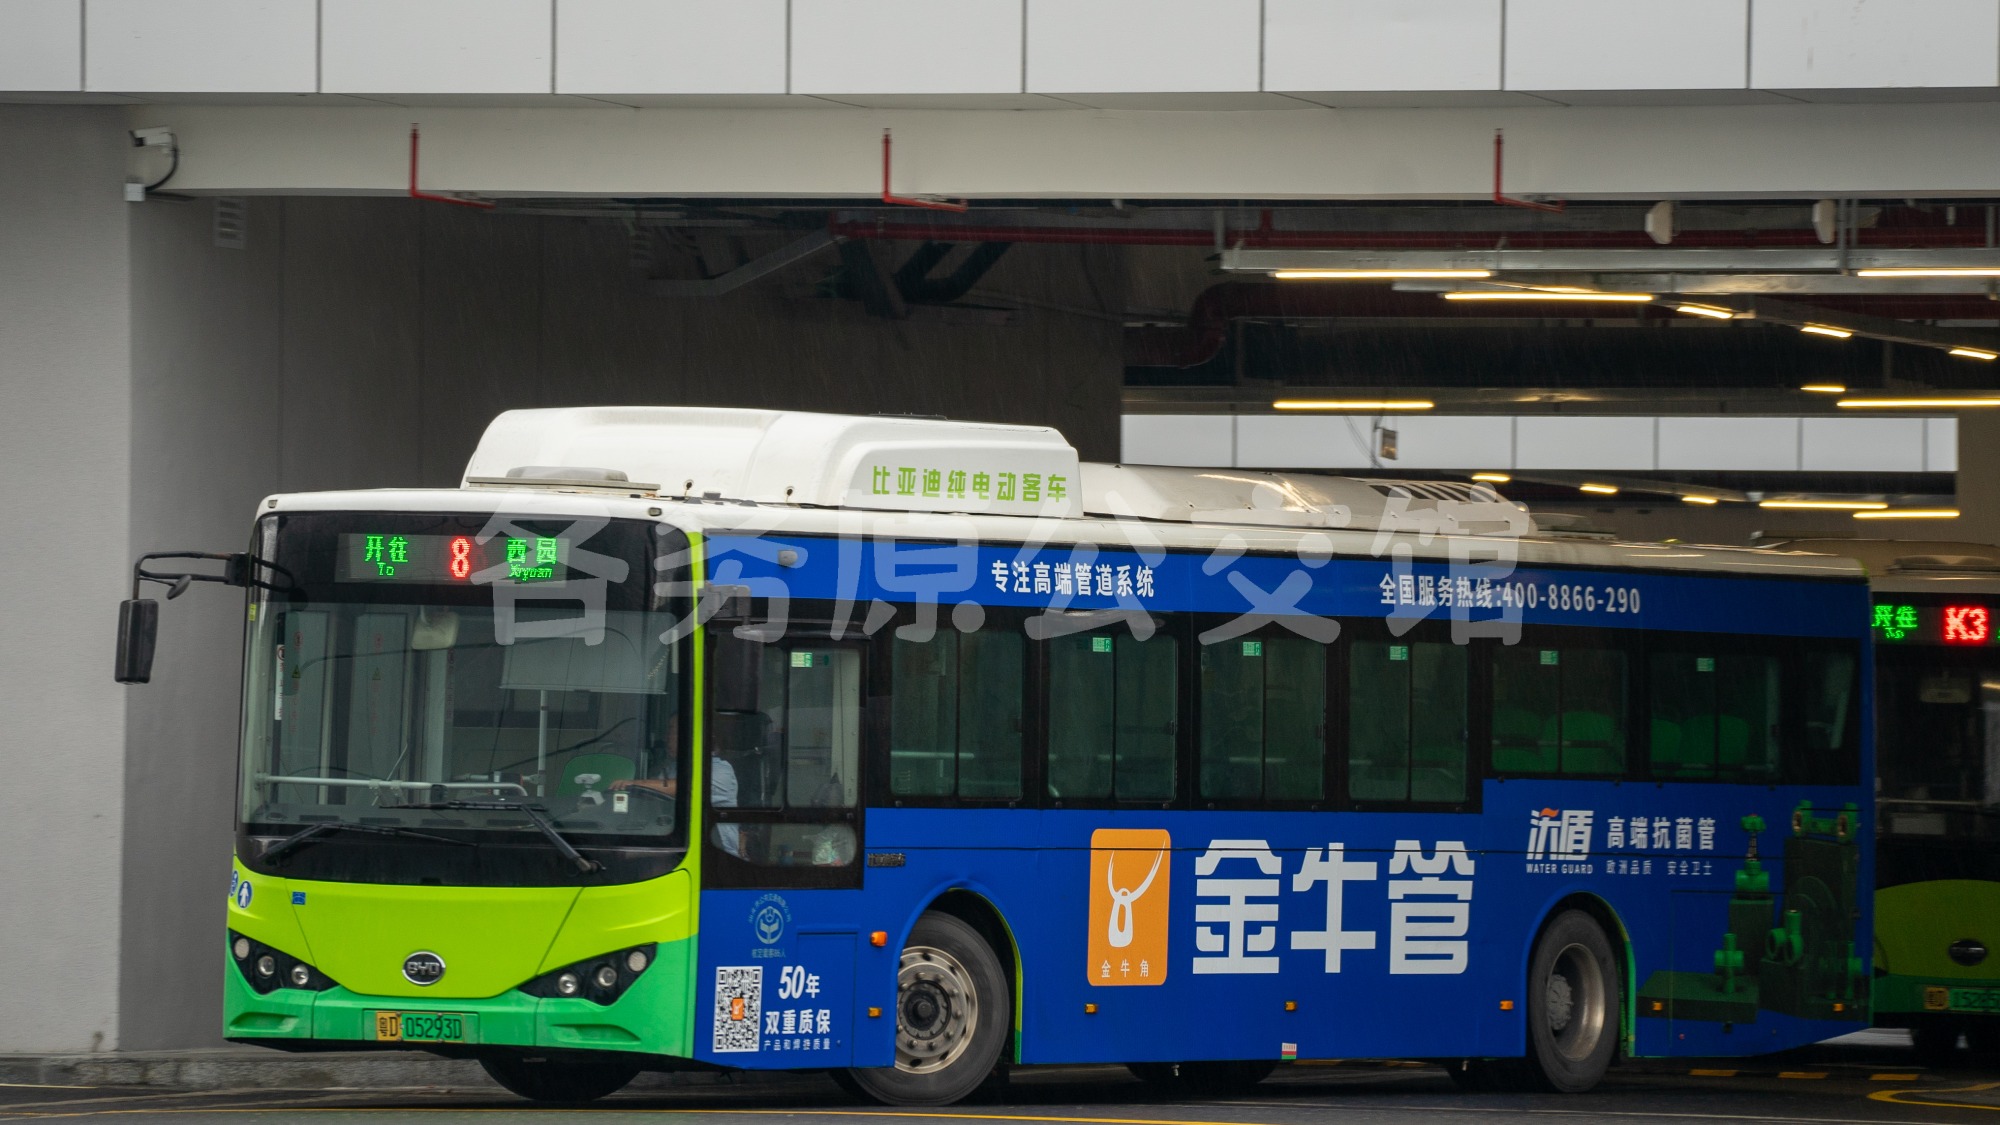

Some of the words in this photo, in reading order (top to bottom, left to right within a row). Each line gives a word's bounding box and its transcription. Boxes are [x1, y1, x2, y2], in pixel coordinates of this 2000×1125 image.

[872, 465, 1067, 503] 比亚迪纯电动客车
[364, 535, 409, 563] 开往
[450, 537, 471, 578] 8
[507, 537, 558, 564] 西园
[376, 562, 396, 576] To
[991, 560, 1154, 597] 专注高端管道系统
[1944, 606, 1988, 641] K3
[1607, 815, 1716, 850] 高端抗菌管
[1526, 863, 1557, 874] WATER
[1561, 863, 1593, 875] GUARD
[1667, 860, 1712, 876] 安全卫士
[1192, 839, 1476, 975] 金牛管
[407, 961, 440, 975] BYD
[778, 965, 820, 999] 50年
[1101, 959, 1149, 978] 金牛角
[764, 1008, 831, 1035] 双重质保
